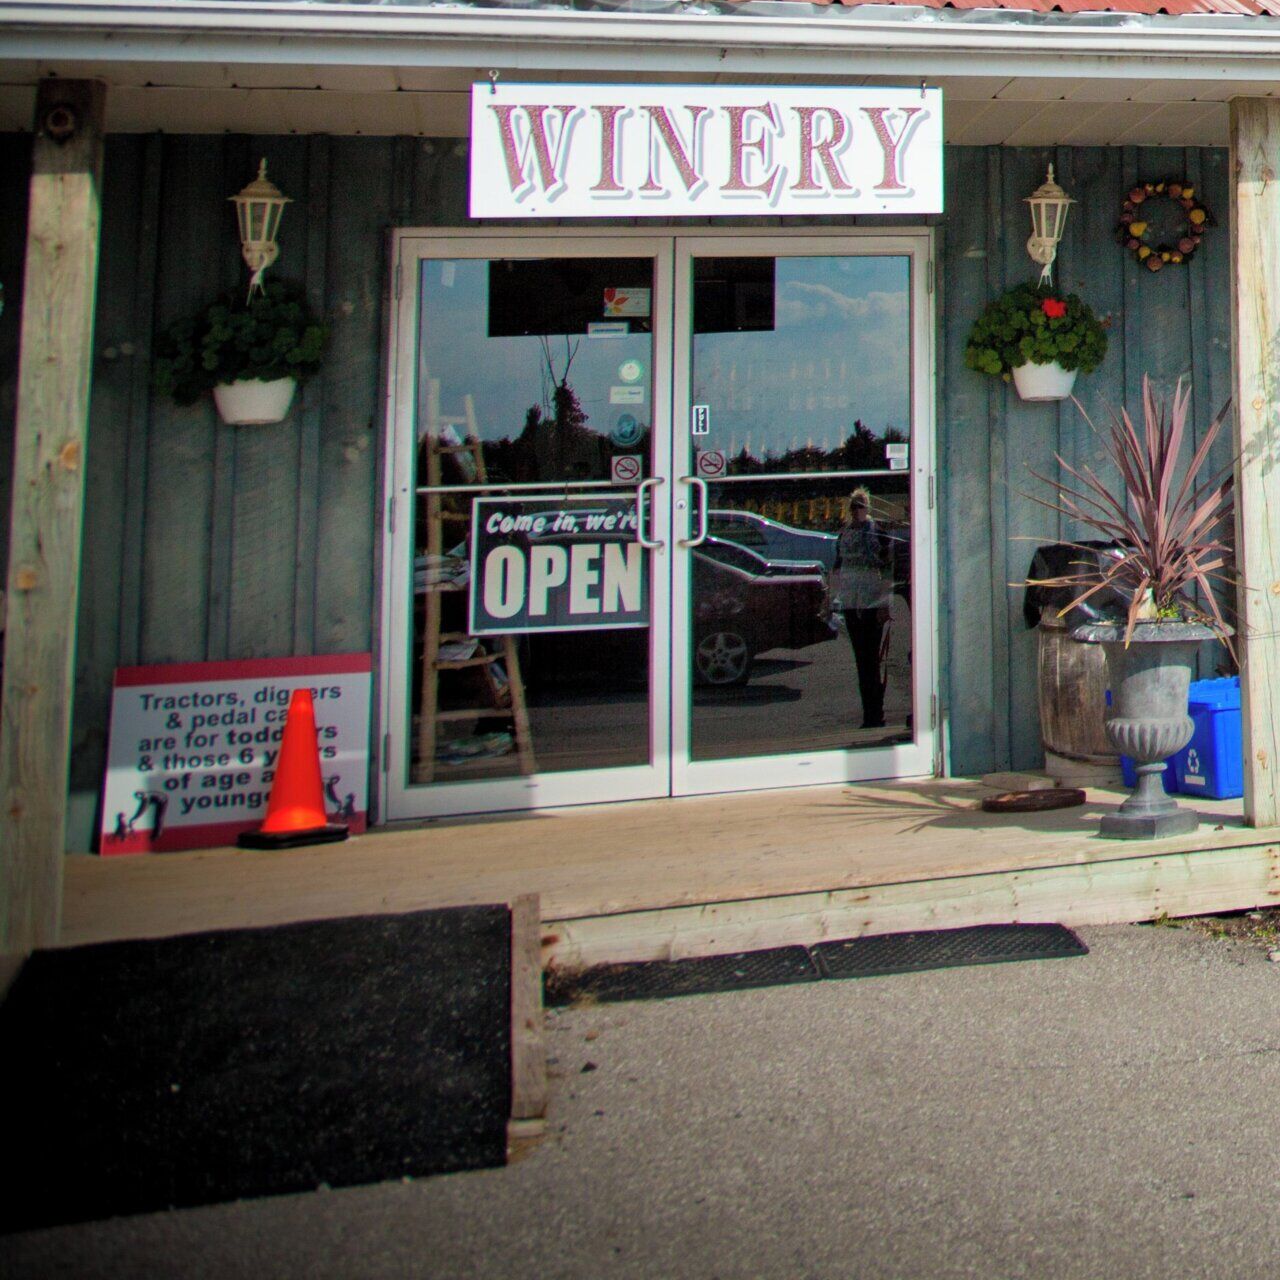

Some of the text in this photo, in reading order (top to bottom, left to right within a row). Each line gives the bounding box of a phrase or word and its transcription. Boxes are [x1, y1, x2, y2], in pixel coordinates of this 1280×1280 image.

[487, 102, 931, 206] WINERY
[486, 512, 546, 533] Come
[552, 510, 579, 533] in,
[484, 543, 642, 619] OPEN
[140, 692, 245, 710] Tractors,
[166, 712, 182, 729] &
[192, 708, 256, 732] pedal
[139, 737, 176, 752] are
[184, 731, 219, 748] for
[138, 755, 153, 772] &
[163, 754, 230, 770] those
[239, 747, 254, 764] 6
[164, 773, 190, 790] of
[201, 773, 251, 790] age
